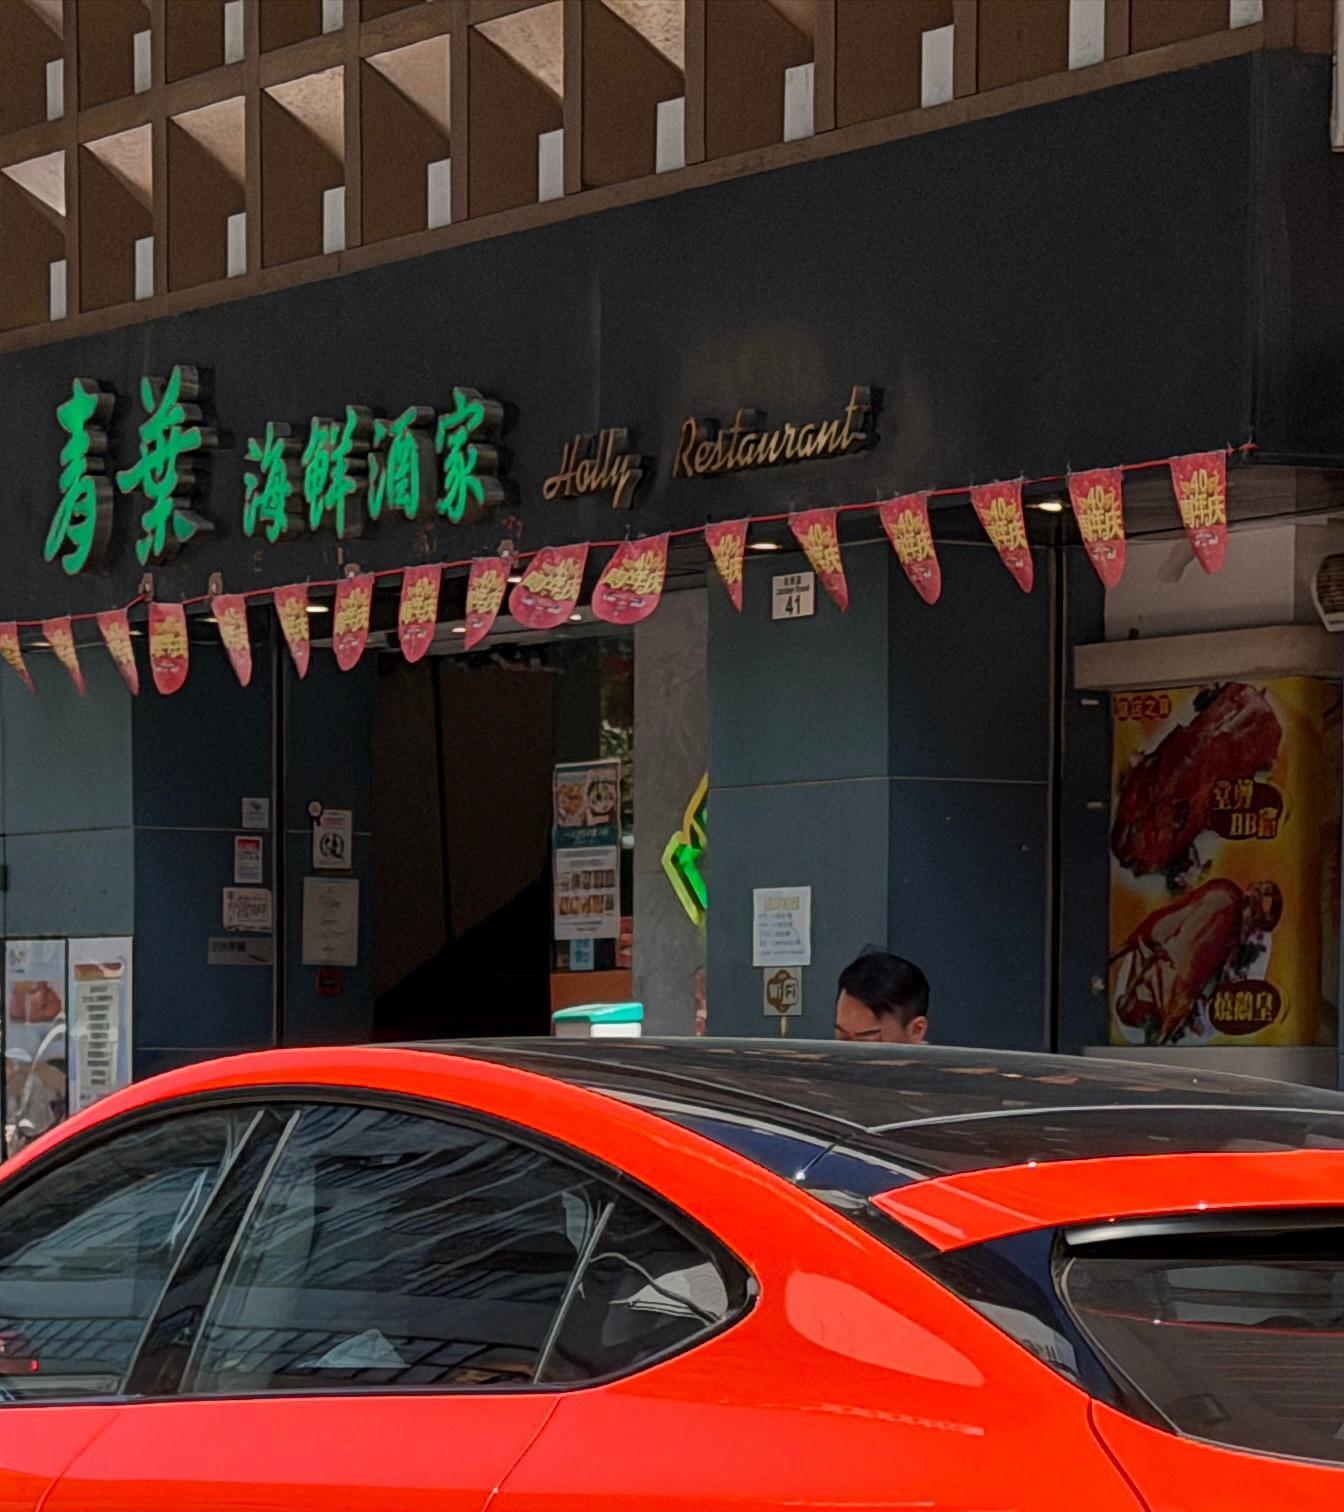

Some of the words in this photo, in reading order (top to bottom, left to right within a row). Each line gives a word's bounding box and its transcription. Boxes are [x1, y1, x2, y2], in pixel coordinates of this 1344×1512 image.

[45, 365, 202, 575] 青葉
[243, 386, 485, 544] 海鮮酒家
[543, 429, 640, 508] Holly
[673, 386, 872, 480] Restaurant
[785, 595, 801, 615] 41
